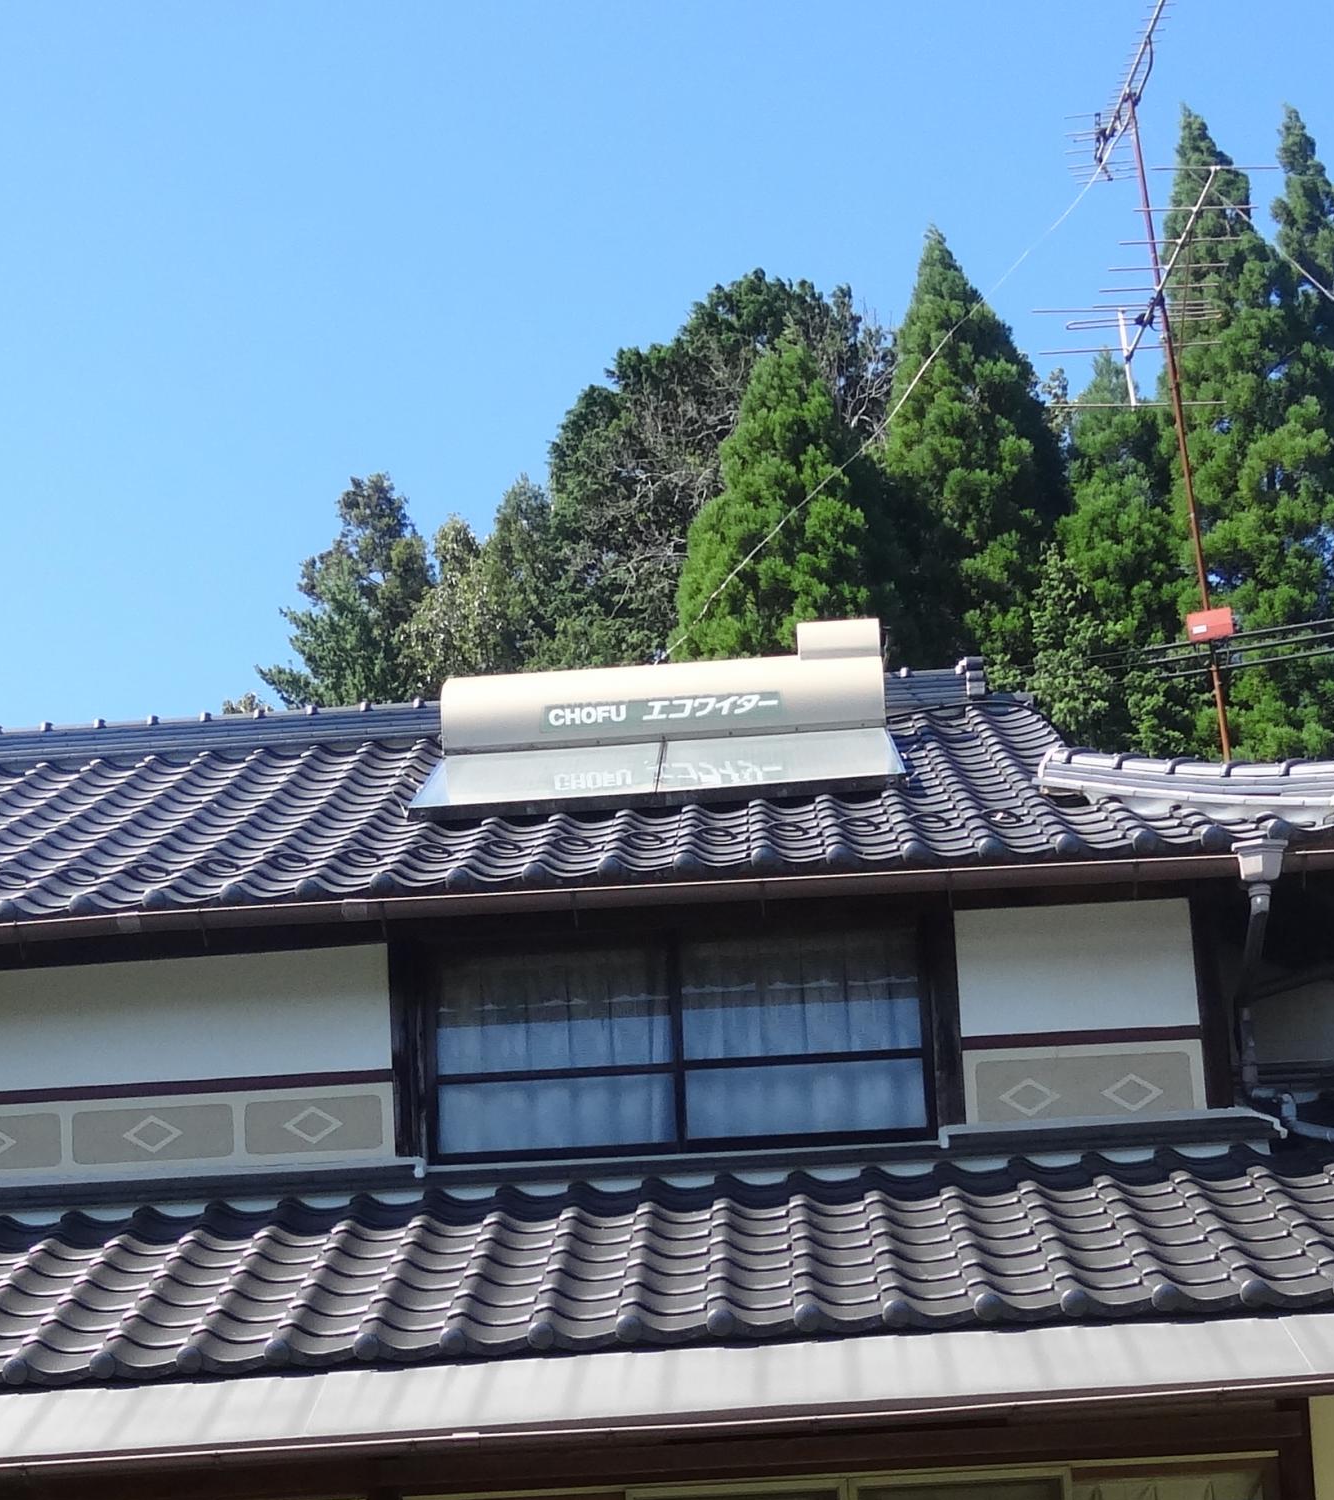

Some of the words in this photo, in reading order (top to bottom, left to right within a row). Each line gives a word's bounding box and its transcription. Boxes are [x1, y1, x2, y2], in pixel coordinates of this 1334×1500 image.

[548, 704, 627, 726] CHOFU
[642, 694, 779, 720] エコワイター
